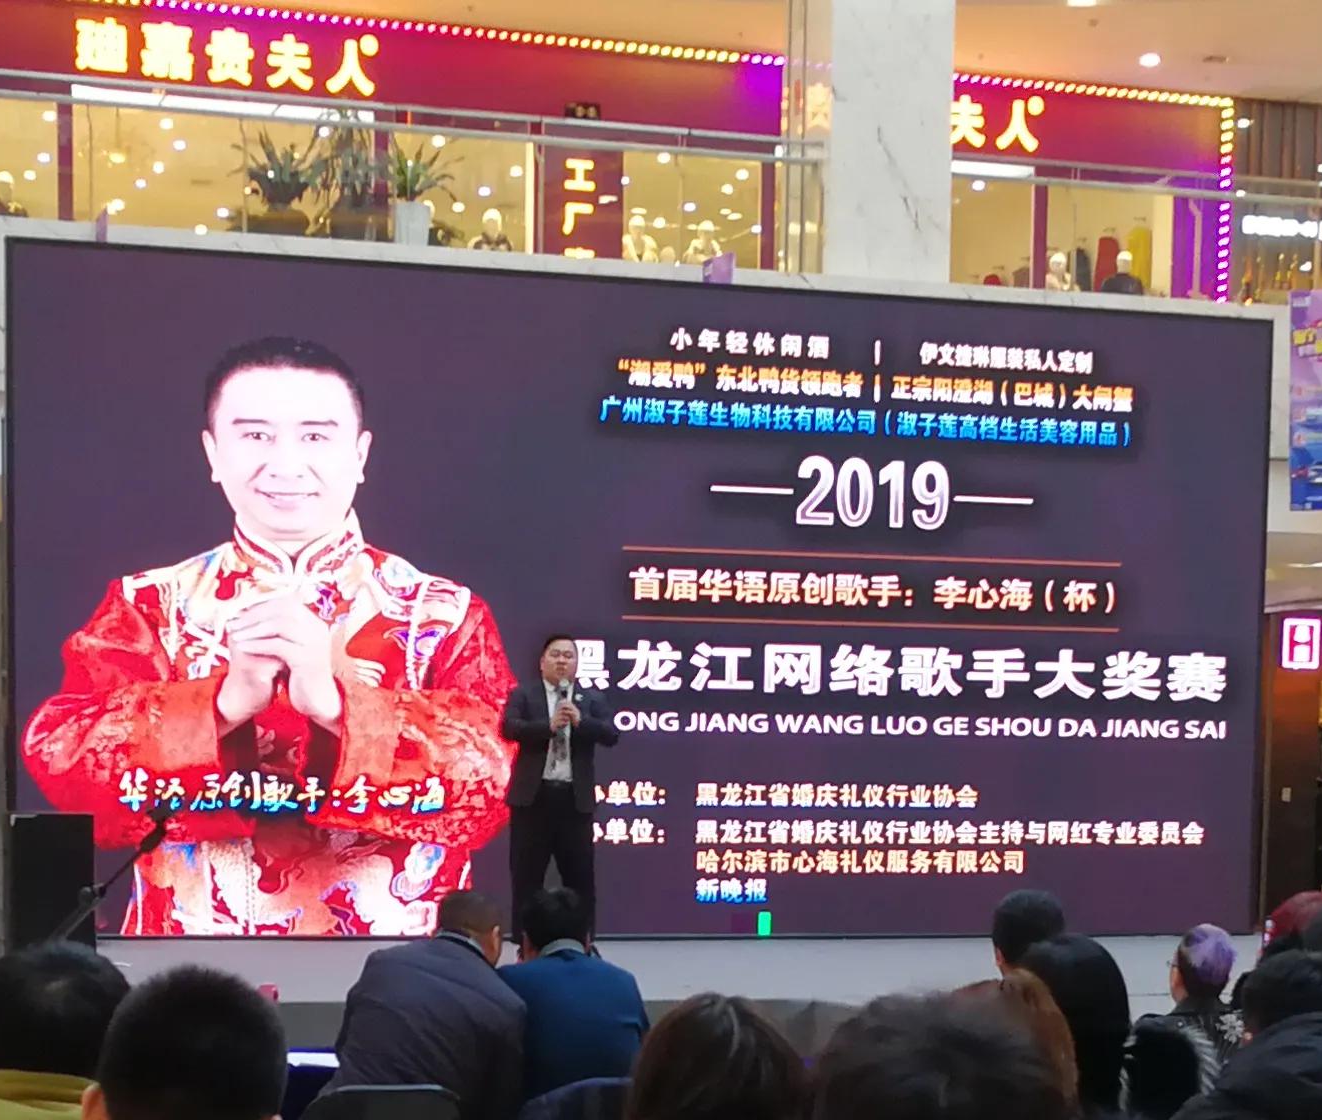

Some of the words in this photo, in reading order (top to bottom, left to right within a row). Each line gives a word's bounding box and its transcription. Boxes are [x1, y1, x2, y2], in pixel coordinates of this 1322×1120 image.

[795, 455, 951, 530] 2019
[575, 639, 1227, 703] 黑龙江网络歌手大奖赛
[685, 712, 770, 734] JIANG
[775, 714, 864, 735] WANG
[871, 715, 927, 736] LUO
[932, 716, 970, 737] GE
[975, 716, 1052, 738] SHOU
[1058, 718, 1097, 738] DA
[1101, 718, 1180, 739] JIANG
[1184, 719, 1227, 740] SAI
[695, 782, 979, 809] 黑龙江省婚庆礼仪行业协会
[695, 849, 1025, 875] 哈尔滨市心海礼仪服务有限公司
[695, 877, 769, 903] 新晚报
